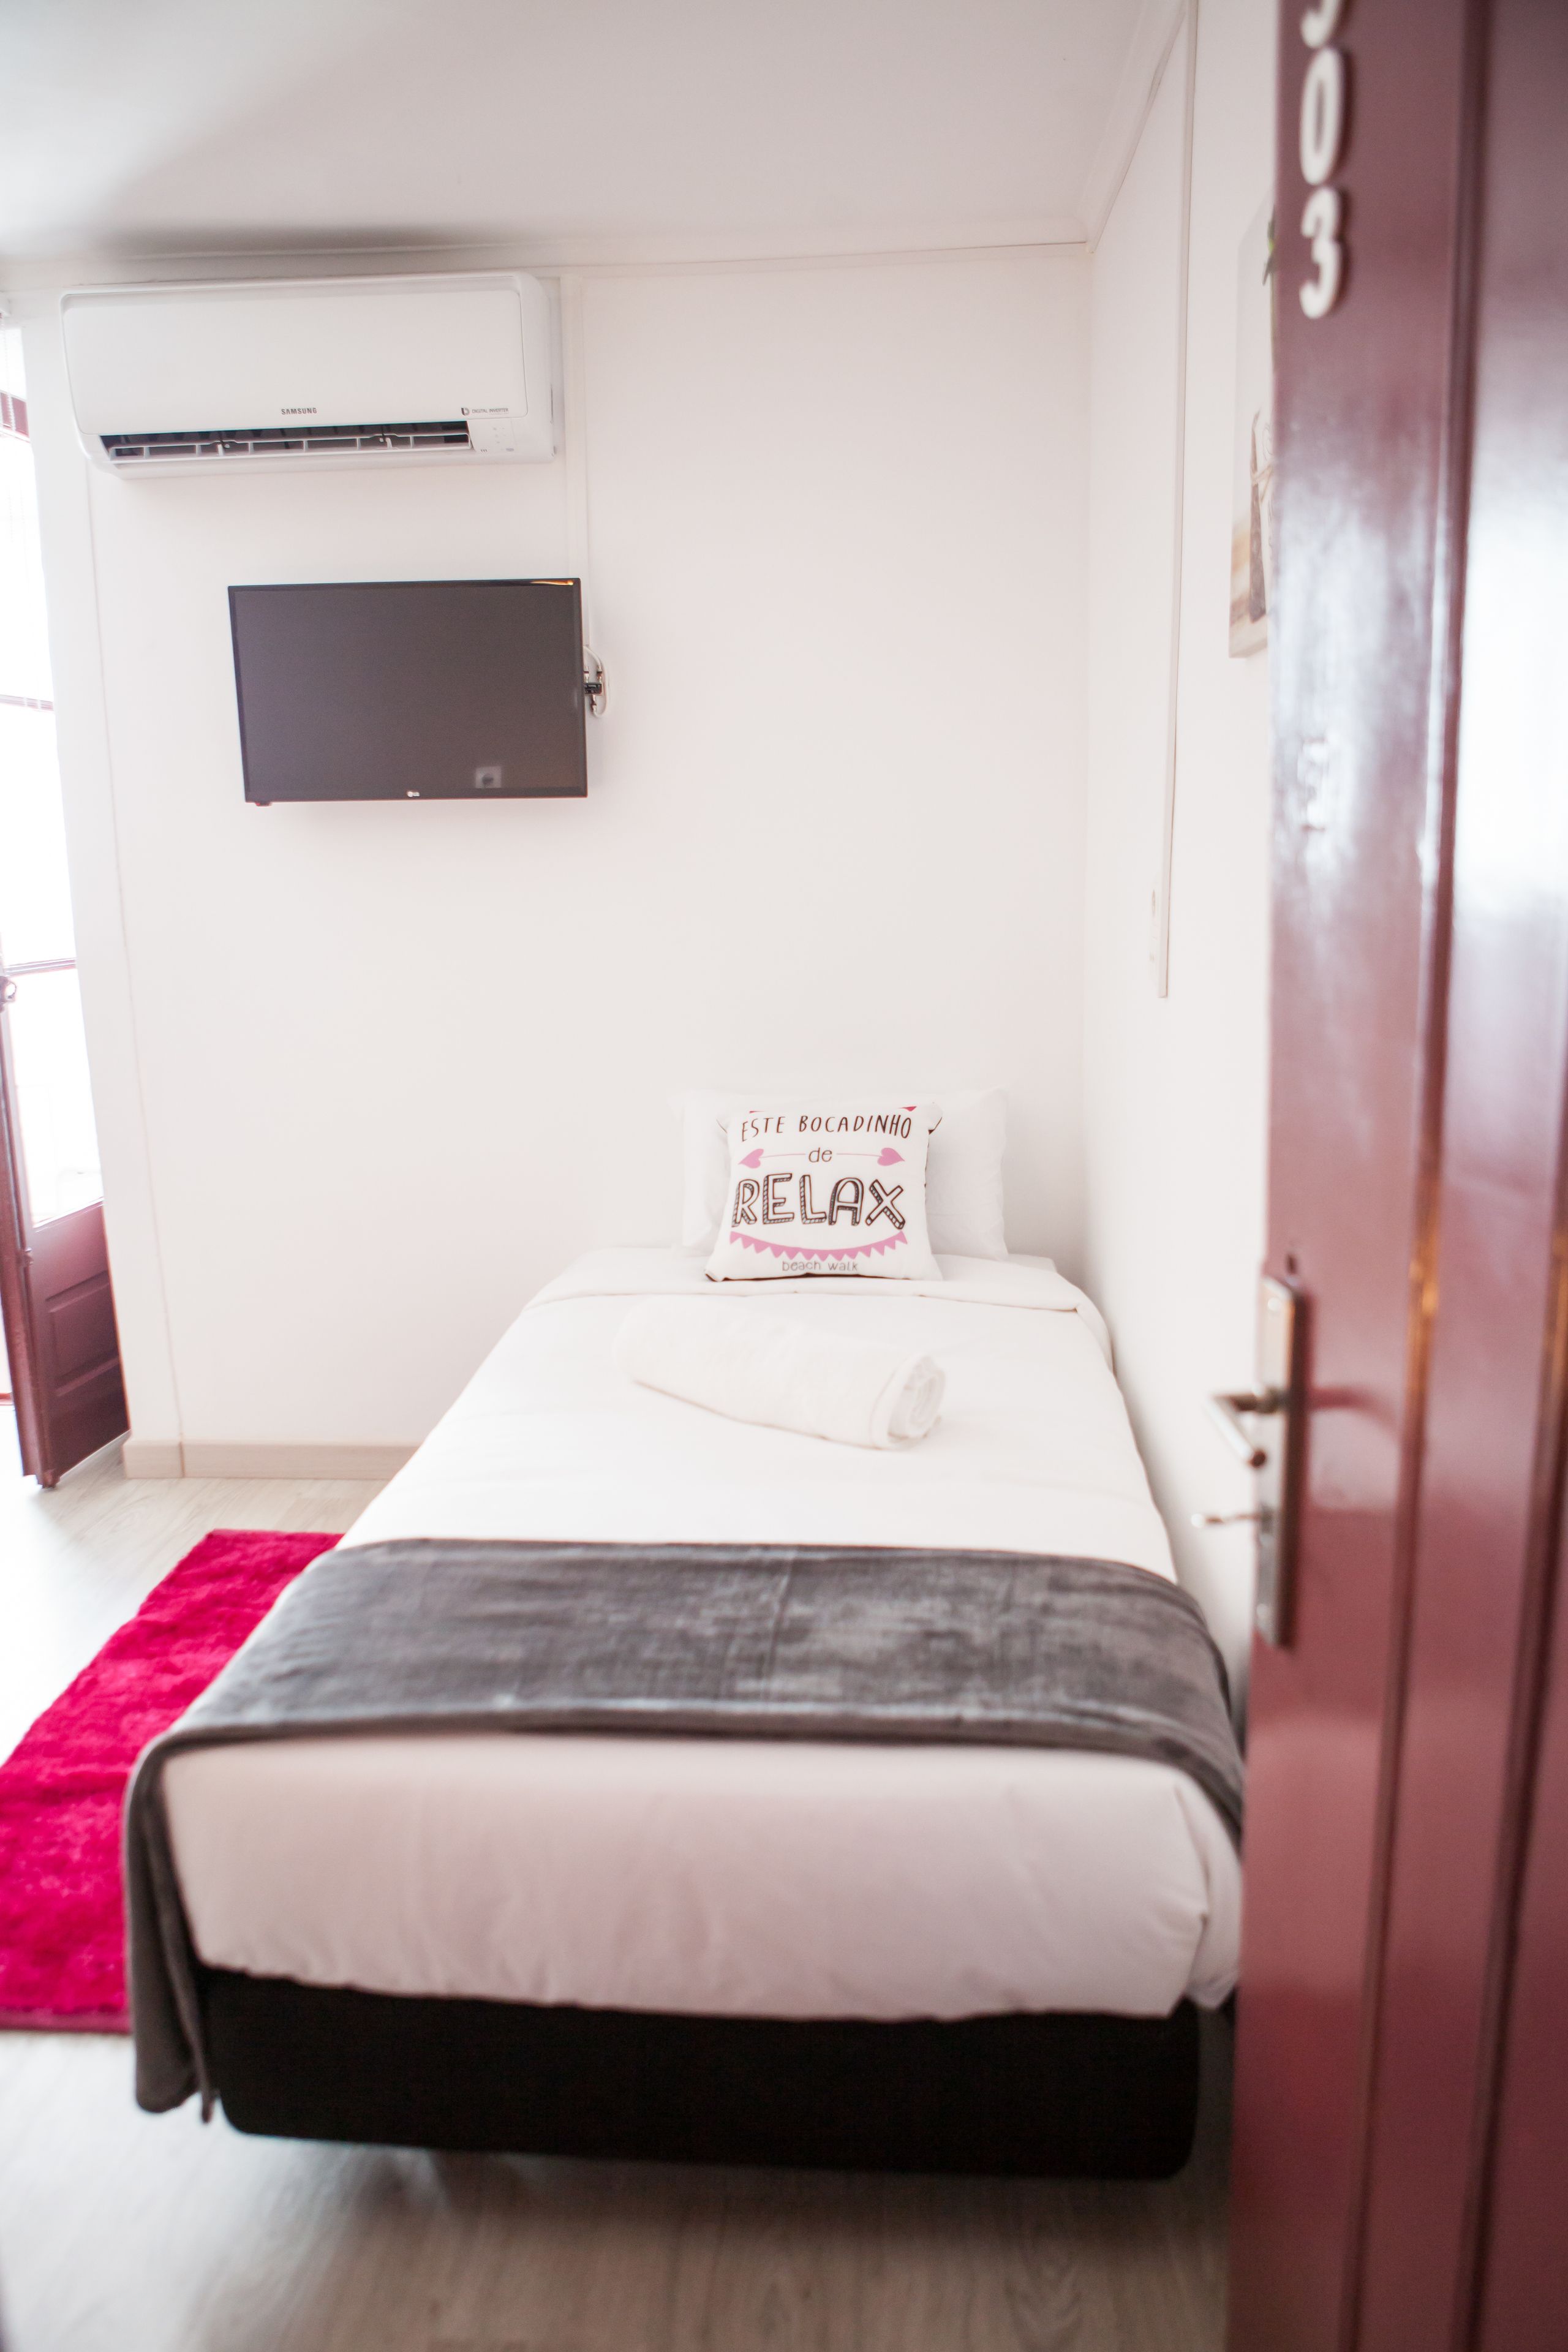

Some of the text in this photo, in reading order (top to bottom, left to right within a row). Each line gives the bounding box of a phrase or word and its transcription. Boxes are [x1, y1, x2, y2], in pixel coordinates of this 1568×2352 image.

[741, 1114, 912, 1142] ESTE BOCADINHO
[808, 1147, 832, 1163] de
[731, 1172, 905, 1230] RELAX
[782, 1260, 858, 1272] beach walk
